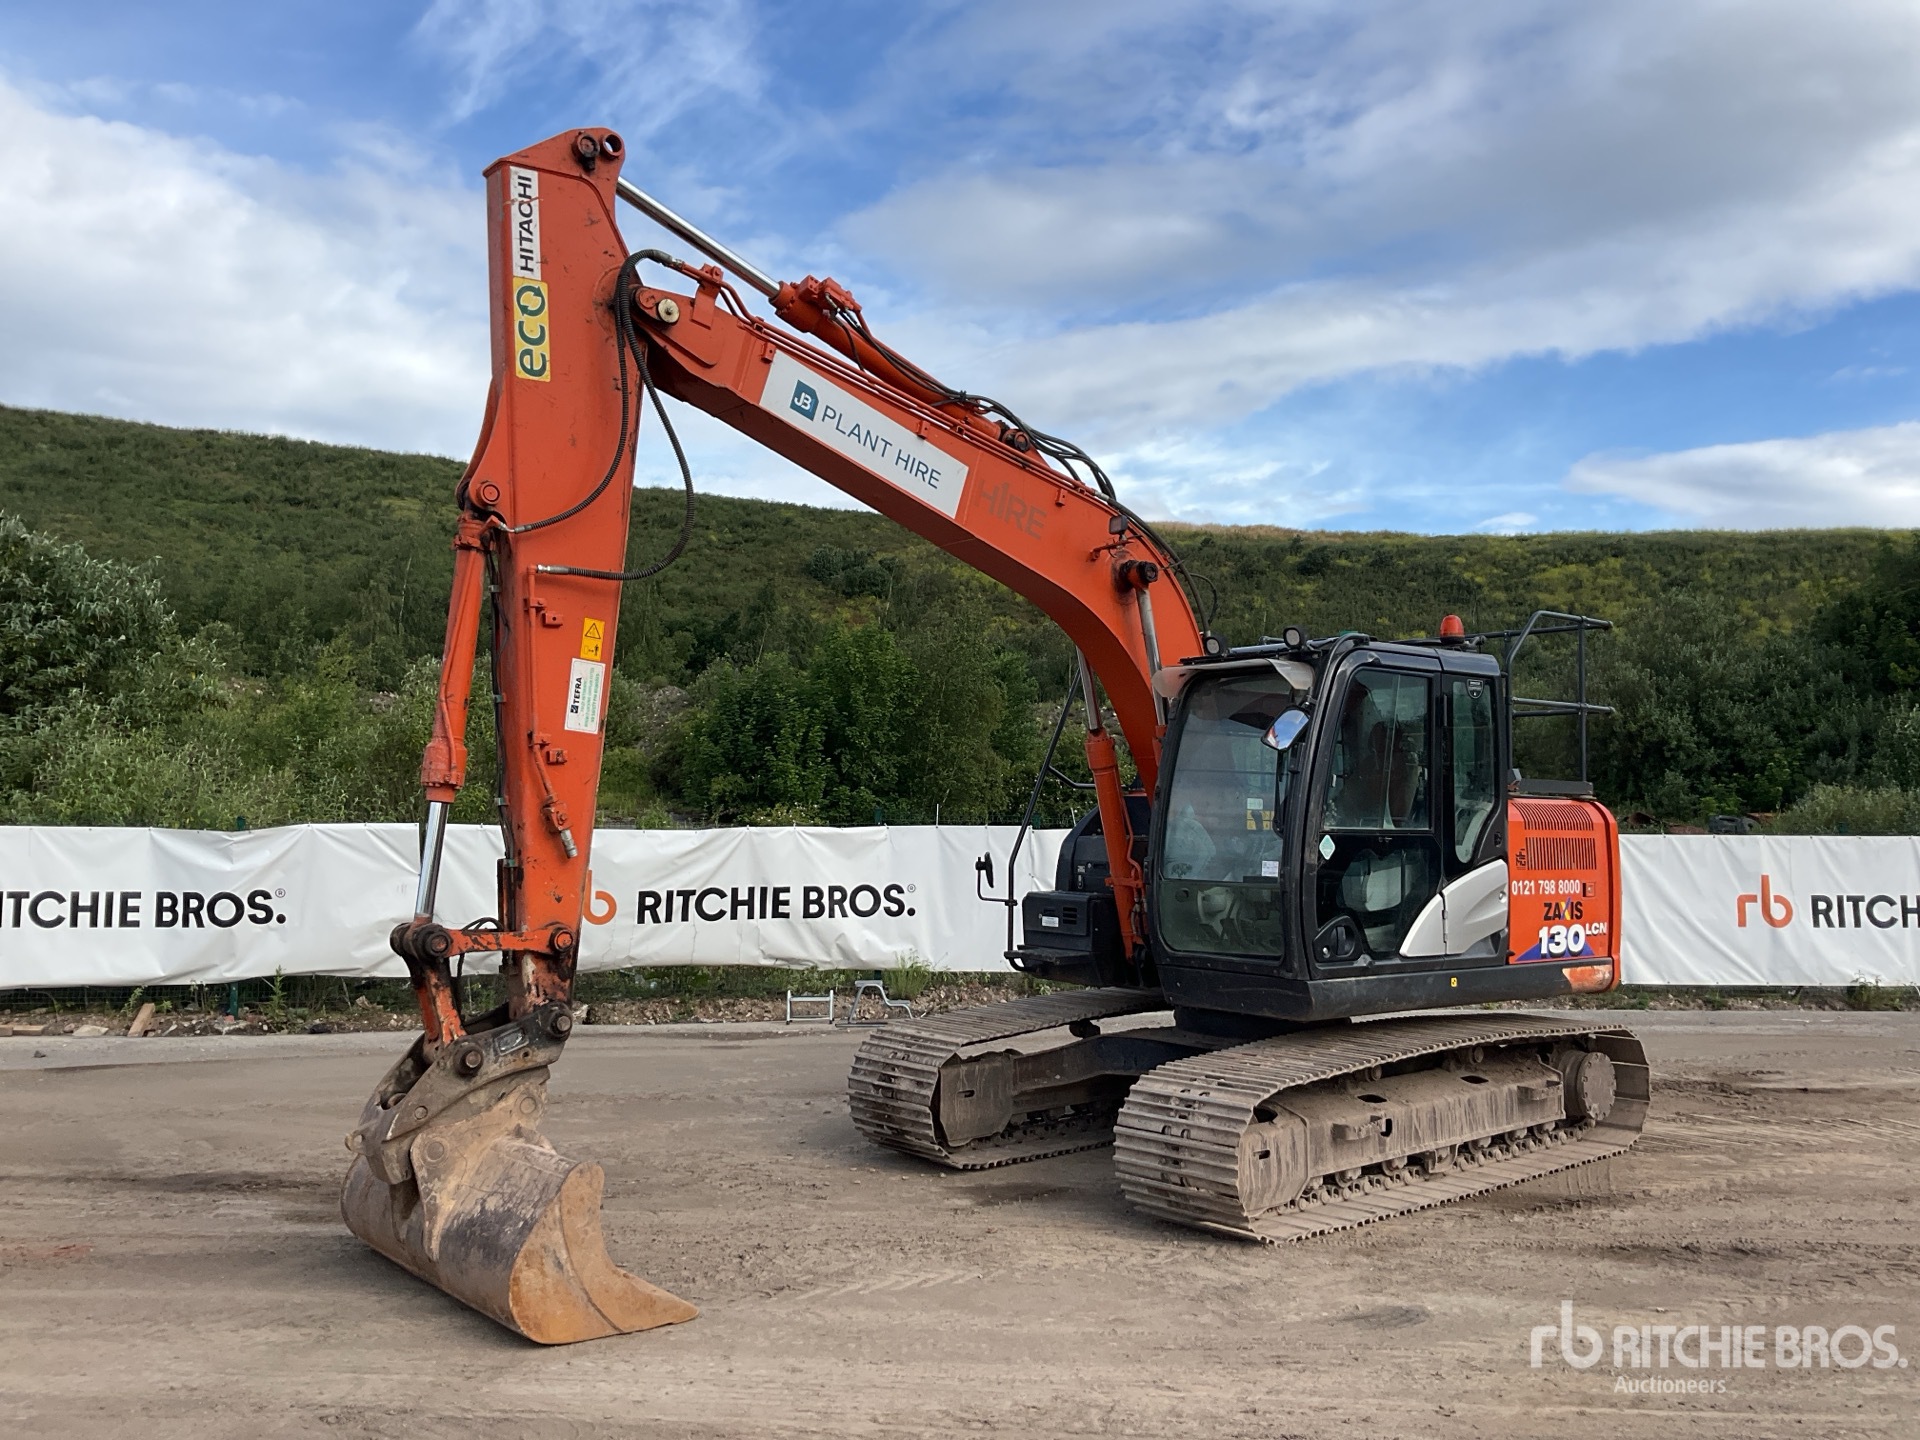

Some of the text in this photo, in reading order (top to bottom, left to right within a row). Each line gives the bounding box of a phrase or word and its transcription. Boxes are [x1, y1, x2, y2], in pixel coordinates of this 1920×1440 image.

[518, 175, 534, 273] HITACHI
[793, 390, 813, 413] JB
[821, 404, 942, 490] PLANT HIRE
[974, 479, 1048, 541] HIRE
[573, 677, 582, 704] TEFRA
[636, 885, 791, 925] RITCHIE
[1511, 879, 1581, 896] 0121 798 8000
[1736, 874, 1793, 928] rb
[1543, 897, 1583, 921] ZAXIS
[1811, 894, 1920, 929] RITCH
[1538, 922, 1607, 958] 130 LCN
